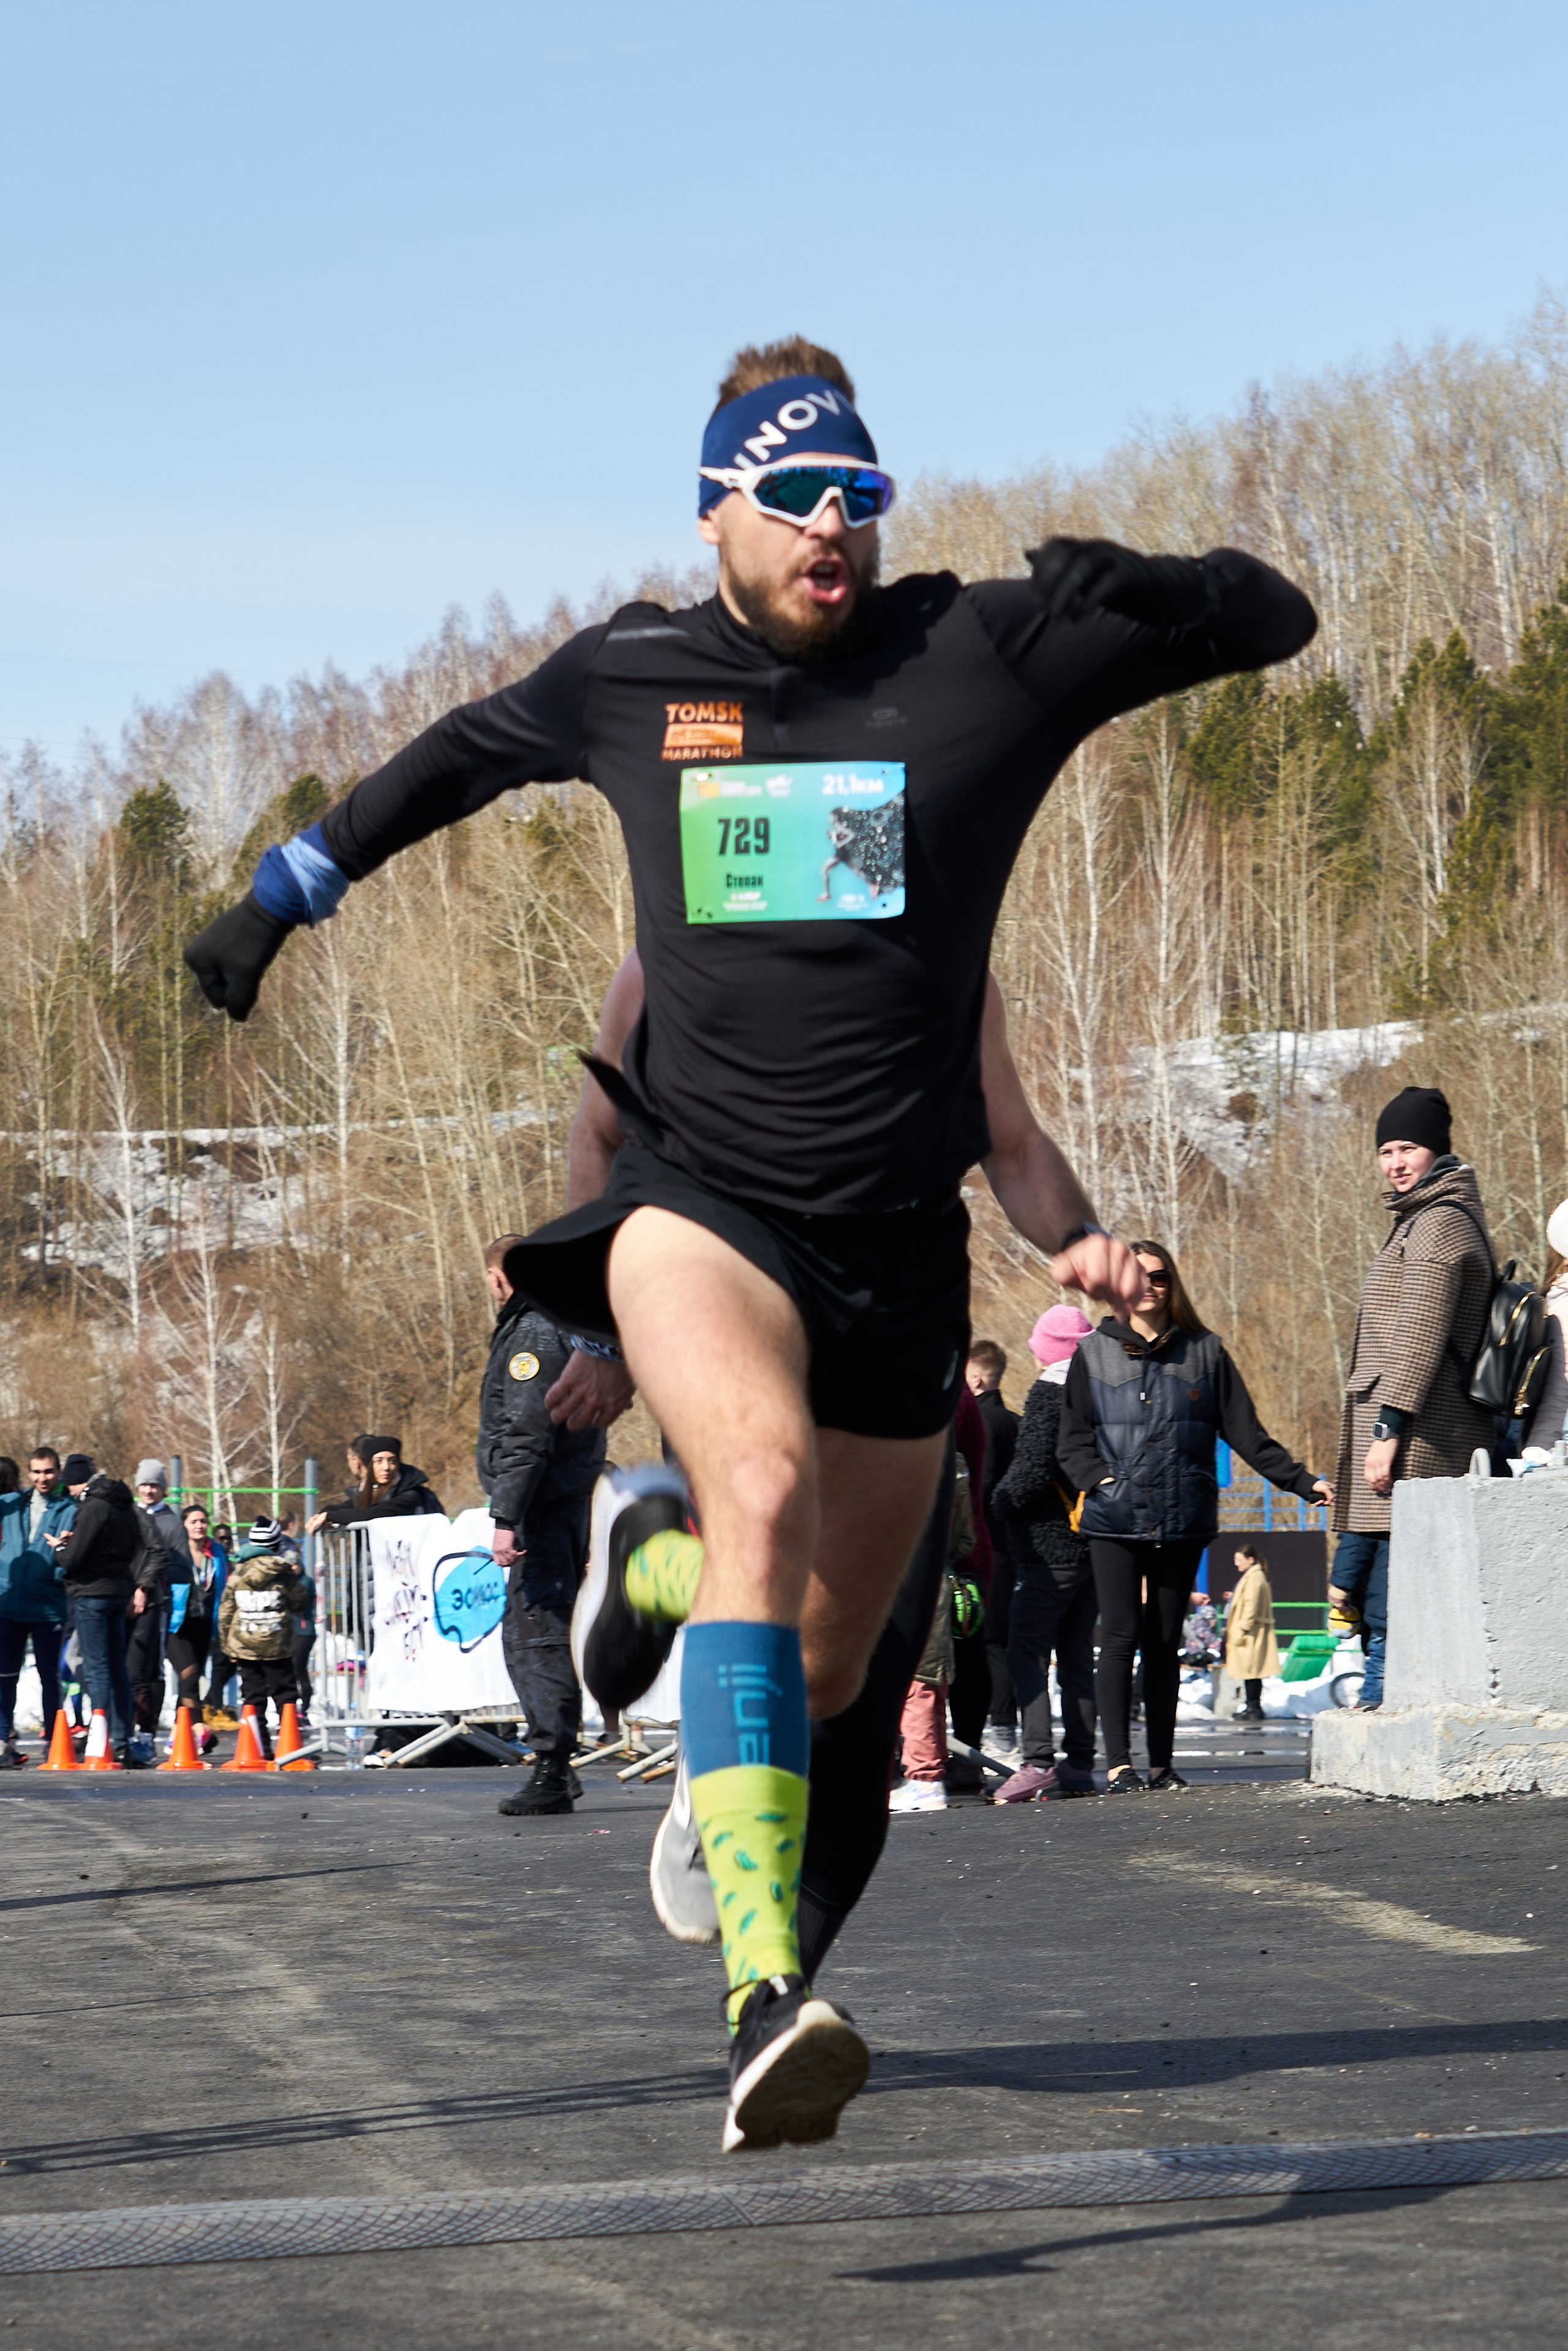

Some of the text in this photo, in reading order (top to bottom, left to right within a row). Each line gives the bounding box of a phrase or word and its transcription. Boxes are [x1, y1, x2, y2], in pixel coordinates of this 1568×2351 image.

[733, 389, 855, 470] INOV
[665, 700, 743, 723] TOMSK
[661, 744, 743, 760] MARATHON
[718, 817, 770, 856] 729
[726, 873, 763, 888] Степан
